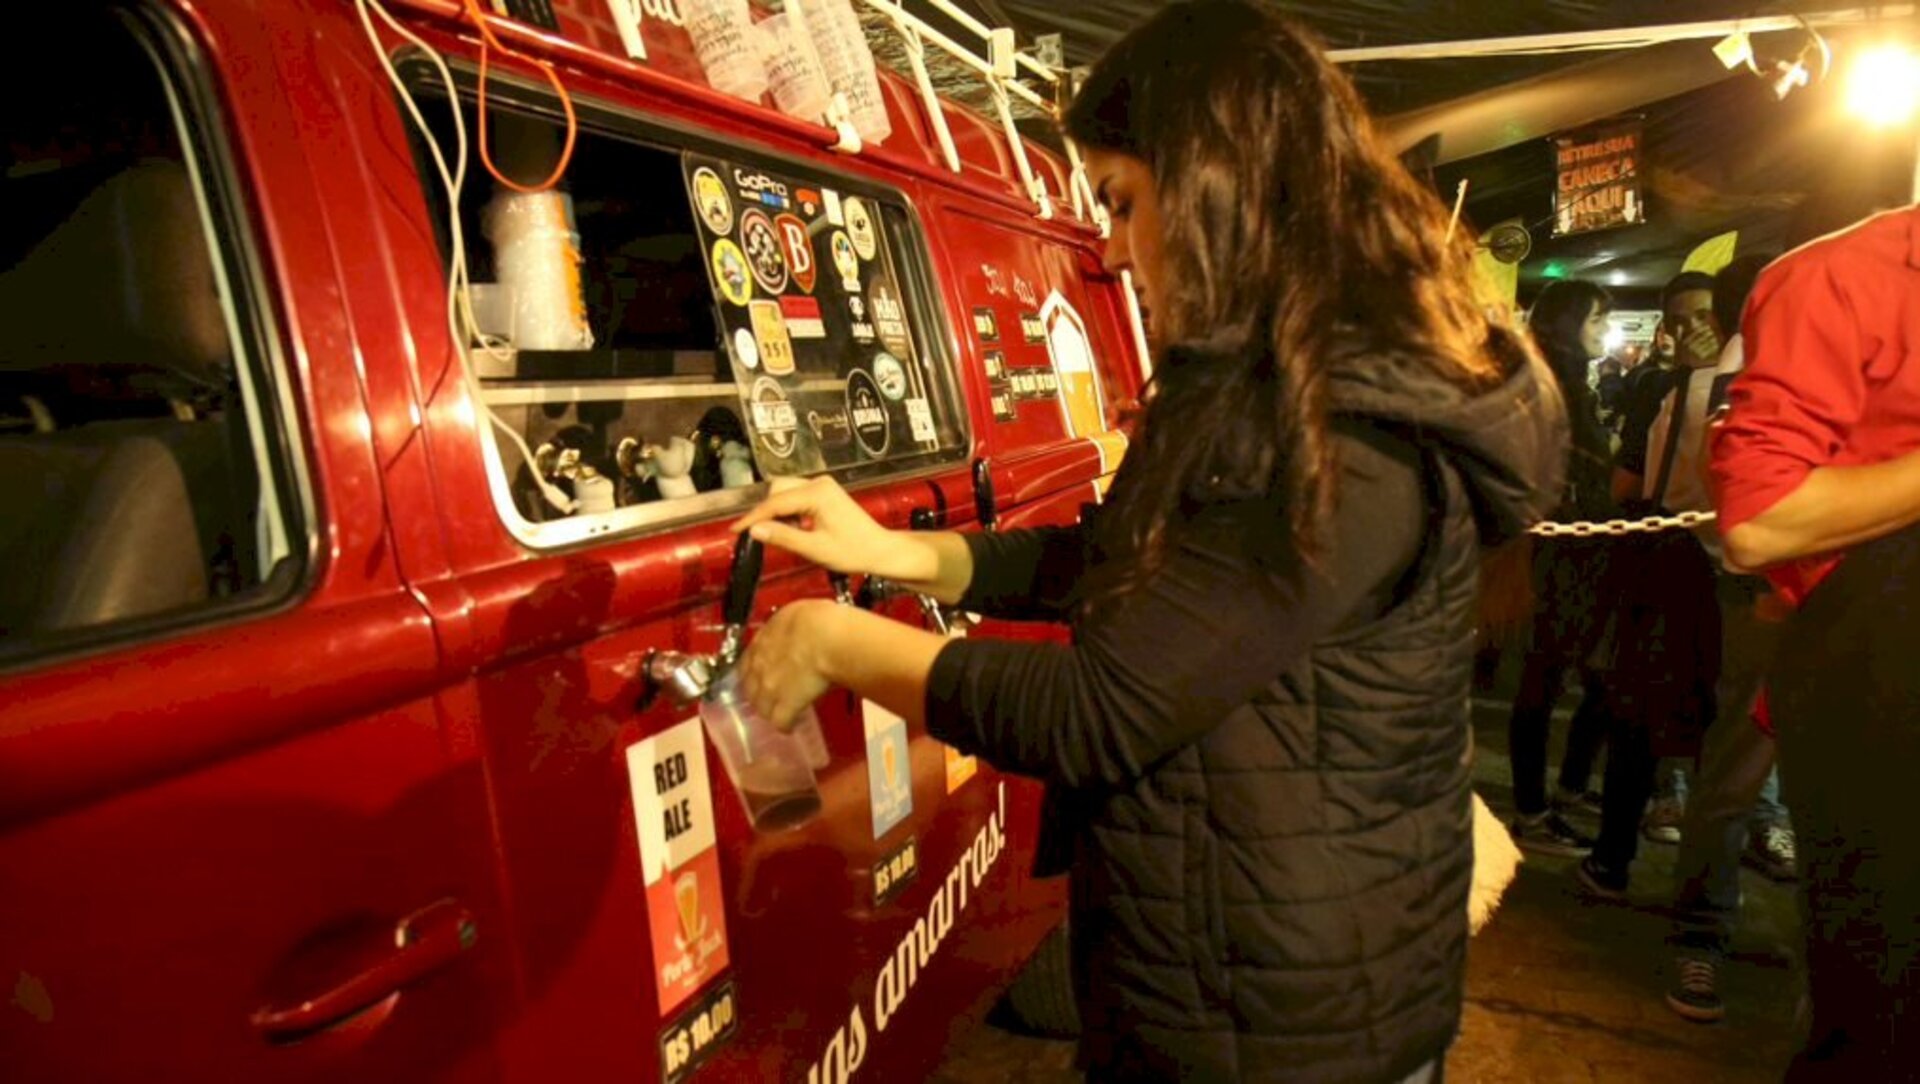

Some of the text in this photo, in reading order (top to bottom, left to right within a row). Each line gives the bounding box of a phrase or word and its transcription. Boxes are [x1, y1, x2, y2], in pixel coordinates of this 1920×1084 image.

[734, 168, 787, 196] GoPro
[1573, 185, 1624, 215] AQUI
[653, 751, 687, 796] RED
[664, 798, 692, 842] ALE
[875, 780, 1005, 1032] amarras!
[665, 1019, 690, 1075] R$
